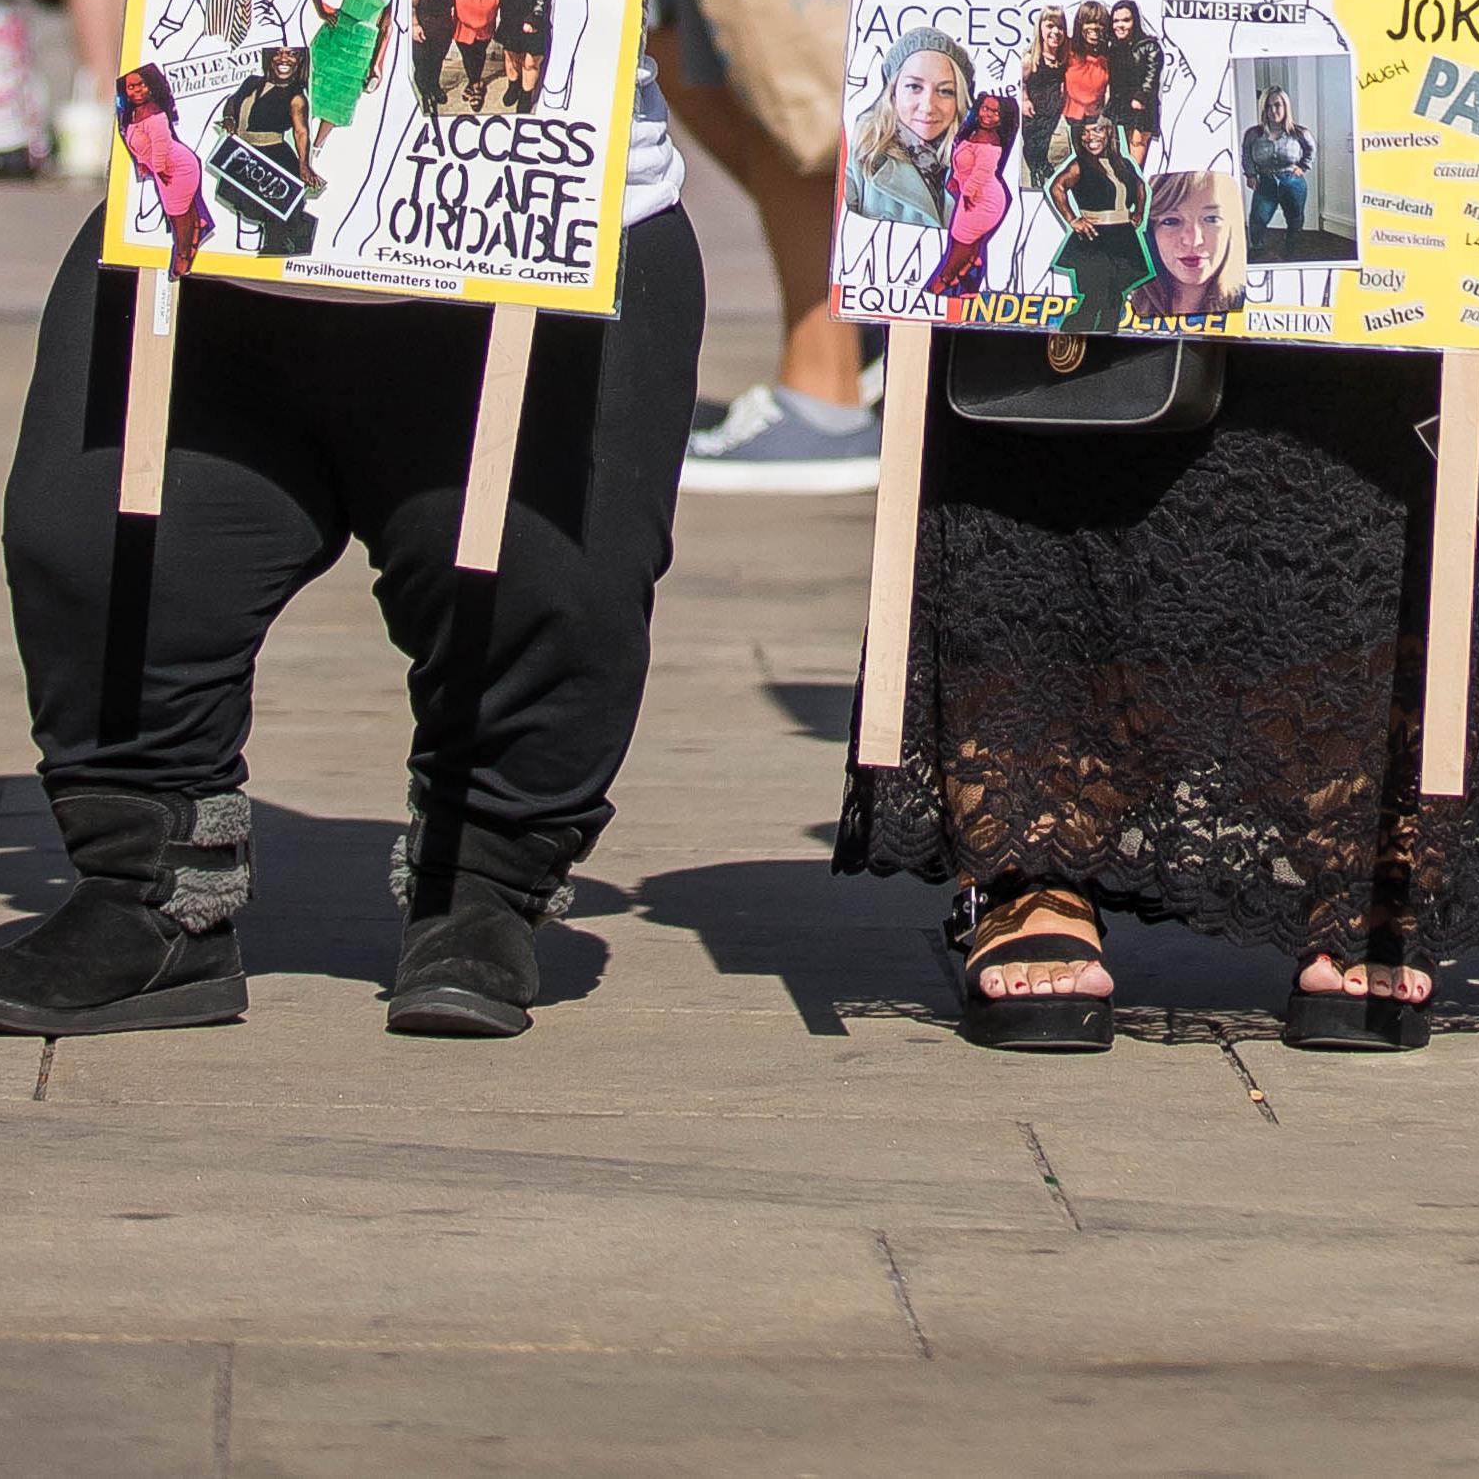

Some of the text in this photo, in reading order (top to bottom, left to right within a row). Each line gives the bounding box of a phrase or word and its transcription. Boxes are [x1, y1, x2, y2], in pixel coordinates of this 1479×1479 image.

[1162, 0, 1306, 24] NUMBER ONE
[168, 60, 223, 83] STYLE
[172, 72, 206, 93] What
[208, 72, 228, 86] we
[1357, 60, 1411, 90] LAUGH
[413, 111, 597, 167] ACCESS
[1361, 133, 1440, 152] powerless
[406, 154, 470, 208] TO
[1361, 192, 1434, 217] near-death
[389, 197, 598, 268] ORDABLE
[1372, 230, 1446, 248] Abuse victims
[375, 246, 512, 277] FASHIONABLE
[285, 260, 458, 291] #mysilhouettematters too
[1359, 268, 1406, 293] body
[841, 285, 946, 318] EQUAL
[1247, 310, 1332, 334] FASHION
[1364, 304, 1425, 332] lashes
